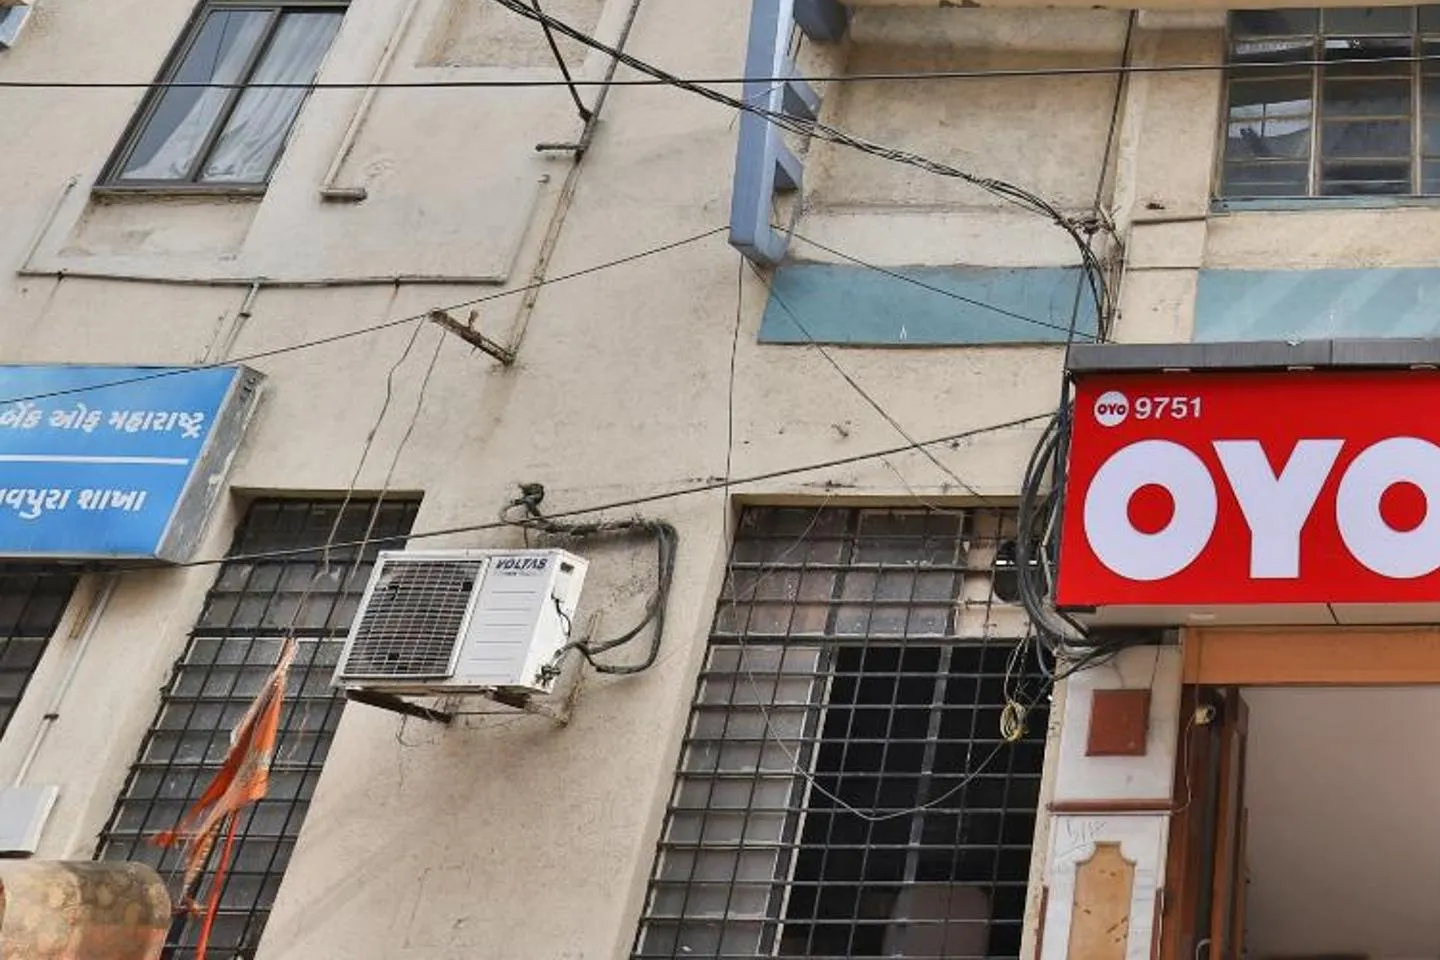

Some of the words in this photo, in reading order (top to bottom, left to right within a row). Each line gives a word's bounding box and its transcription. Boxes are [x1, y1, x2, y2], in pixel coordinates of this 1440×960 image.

[1097, 403, 1127, 416] OYO
[1134, 396, 1201, 419] 9751
[496, 557, 548, 570] VOLTAS
